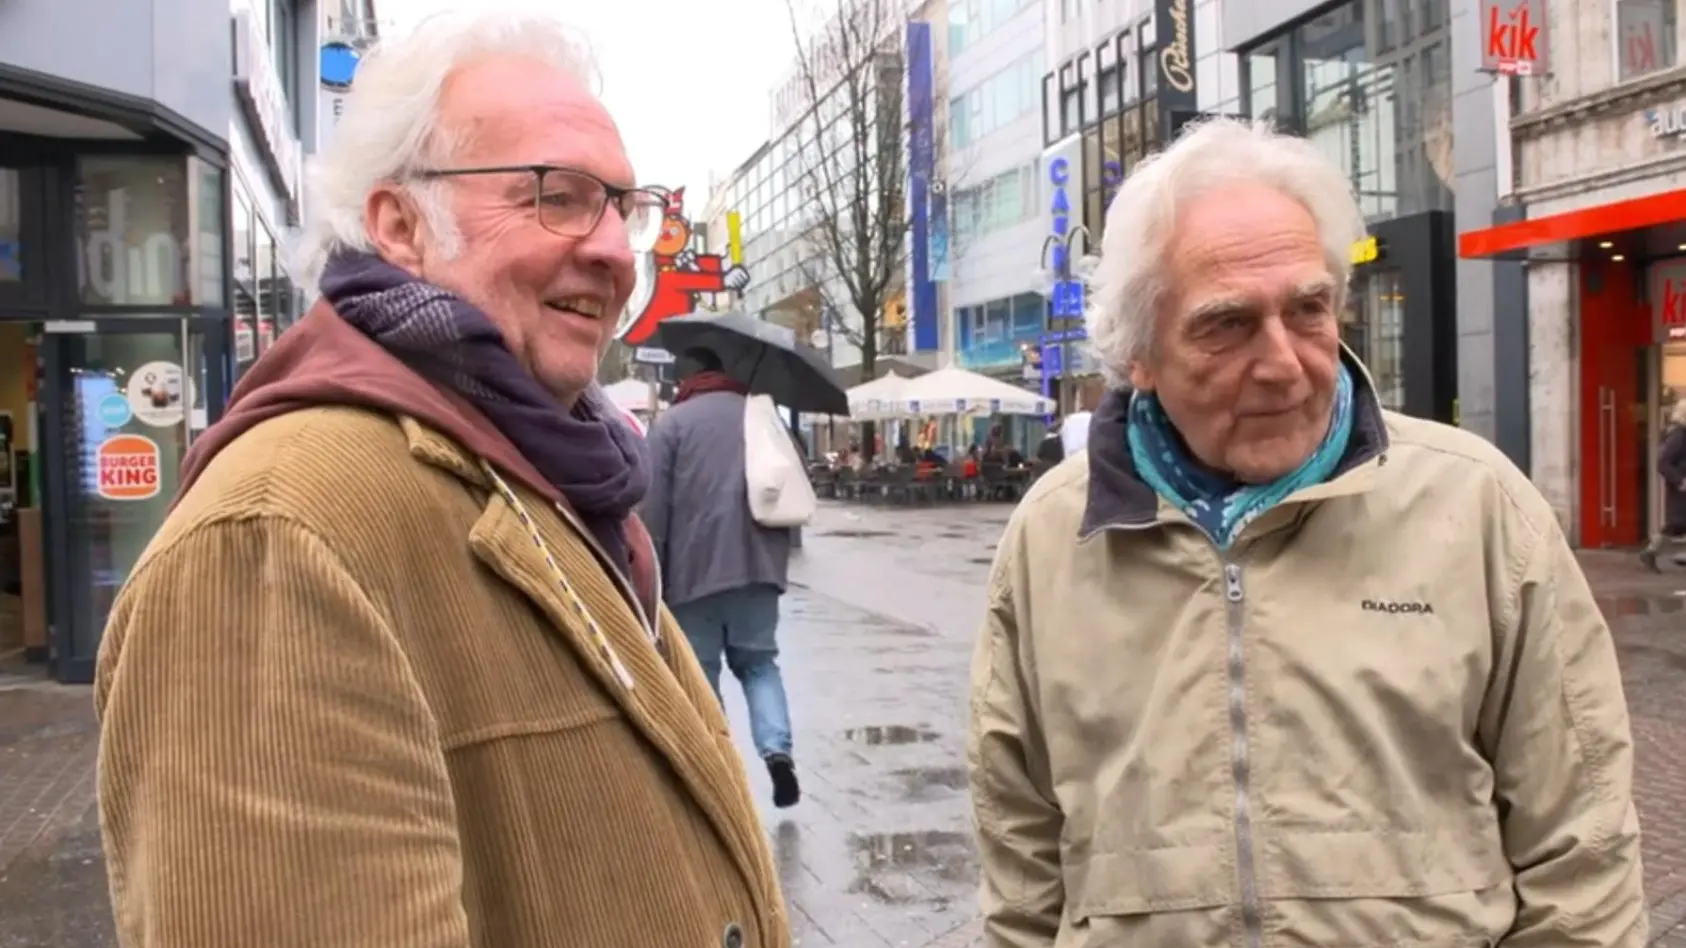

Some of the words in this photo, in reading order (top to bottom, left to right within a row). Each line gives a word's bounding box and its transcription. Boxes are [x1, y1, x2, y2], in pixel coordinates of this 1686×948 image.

[1489, 5, 1539, 61] kik
[100, 456, 157, 467] BURGER
[101, 469, 157, 485] KING
